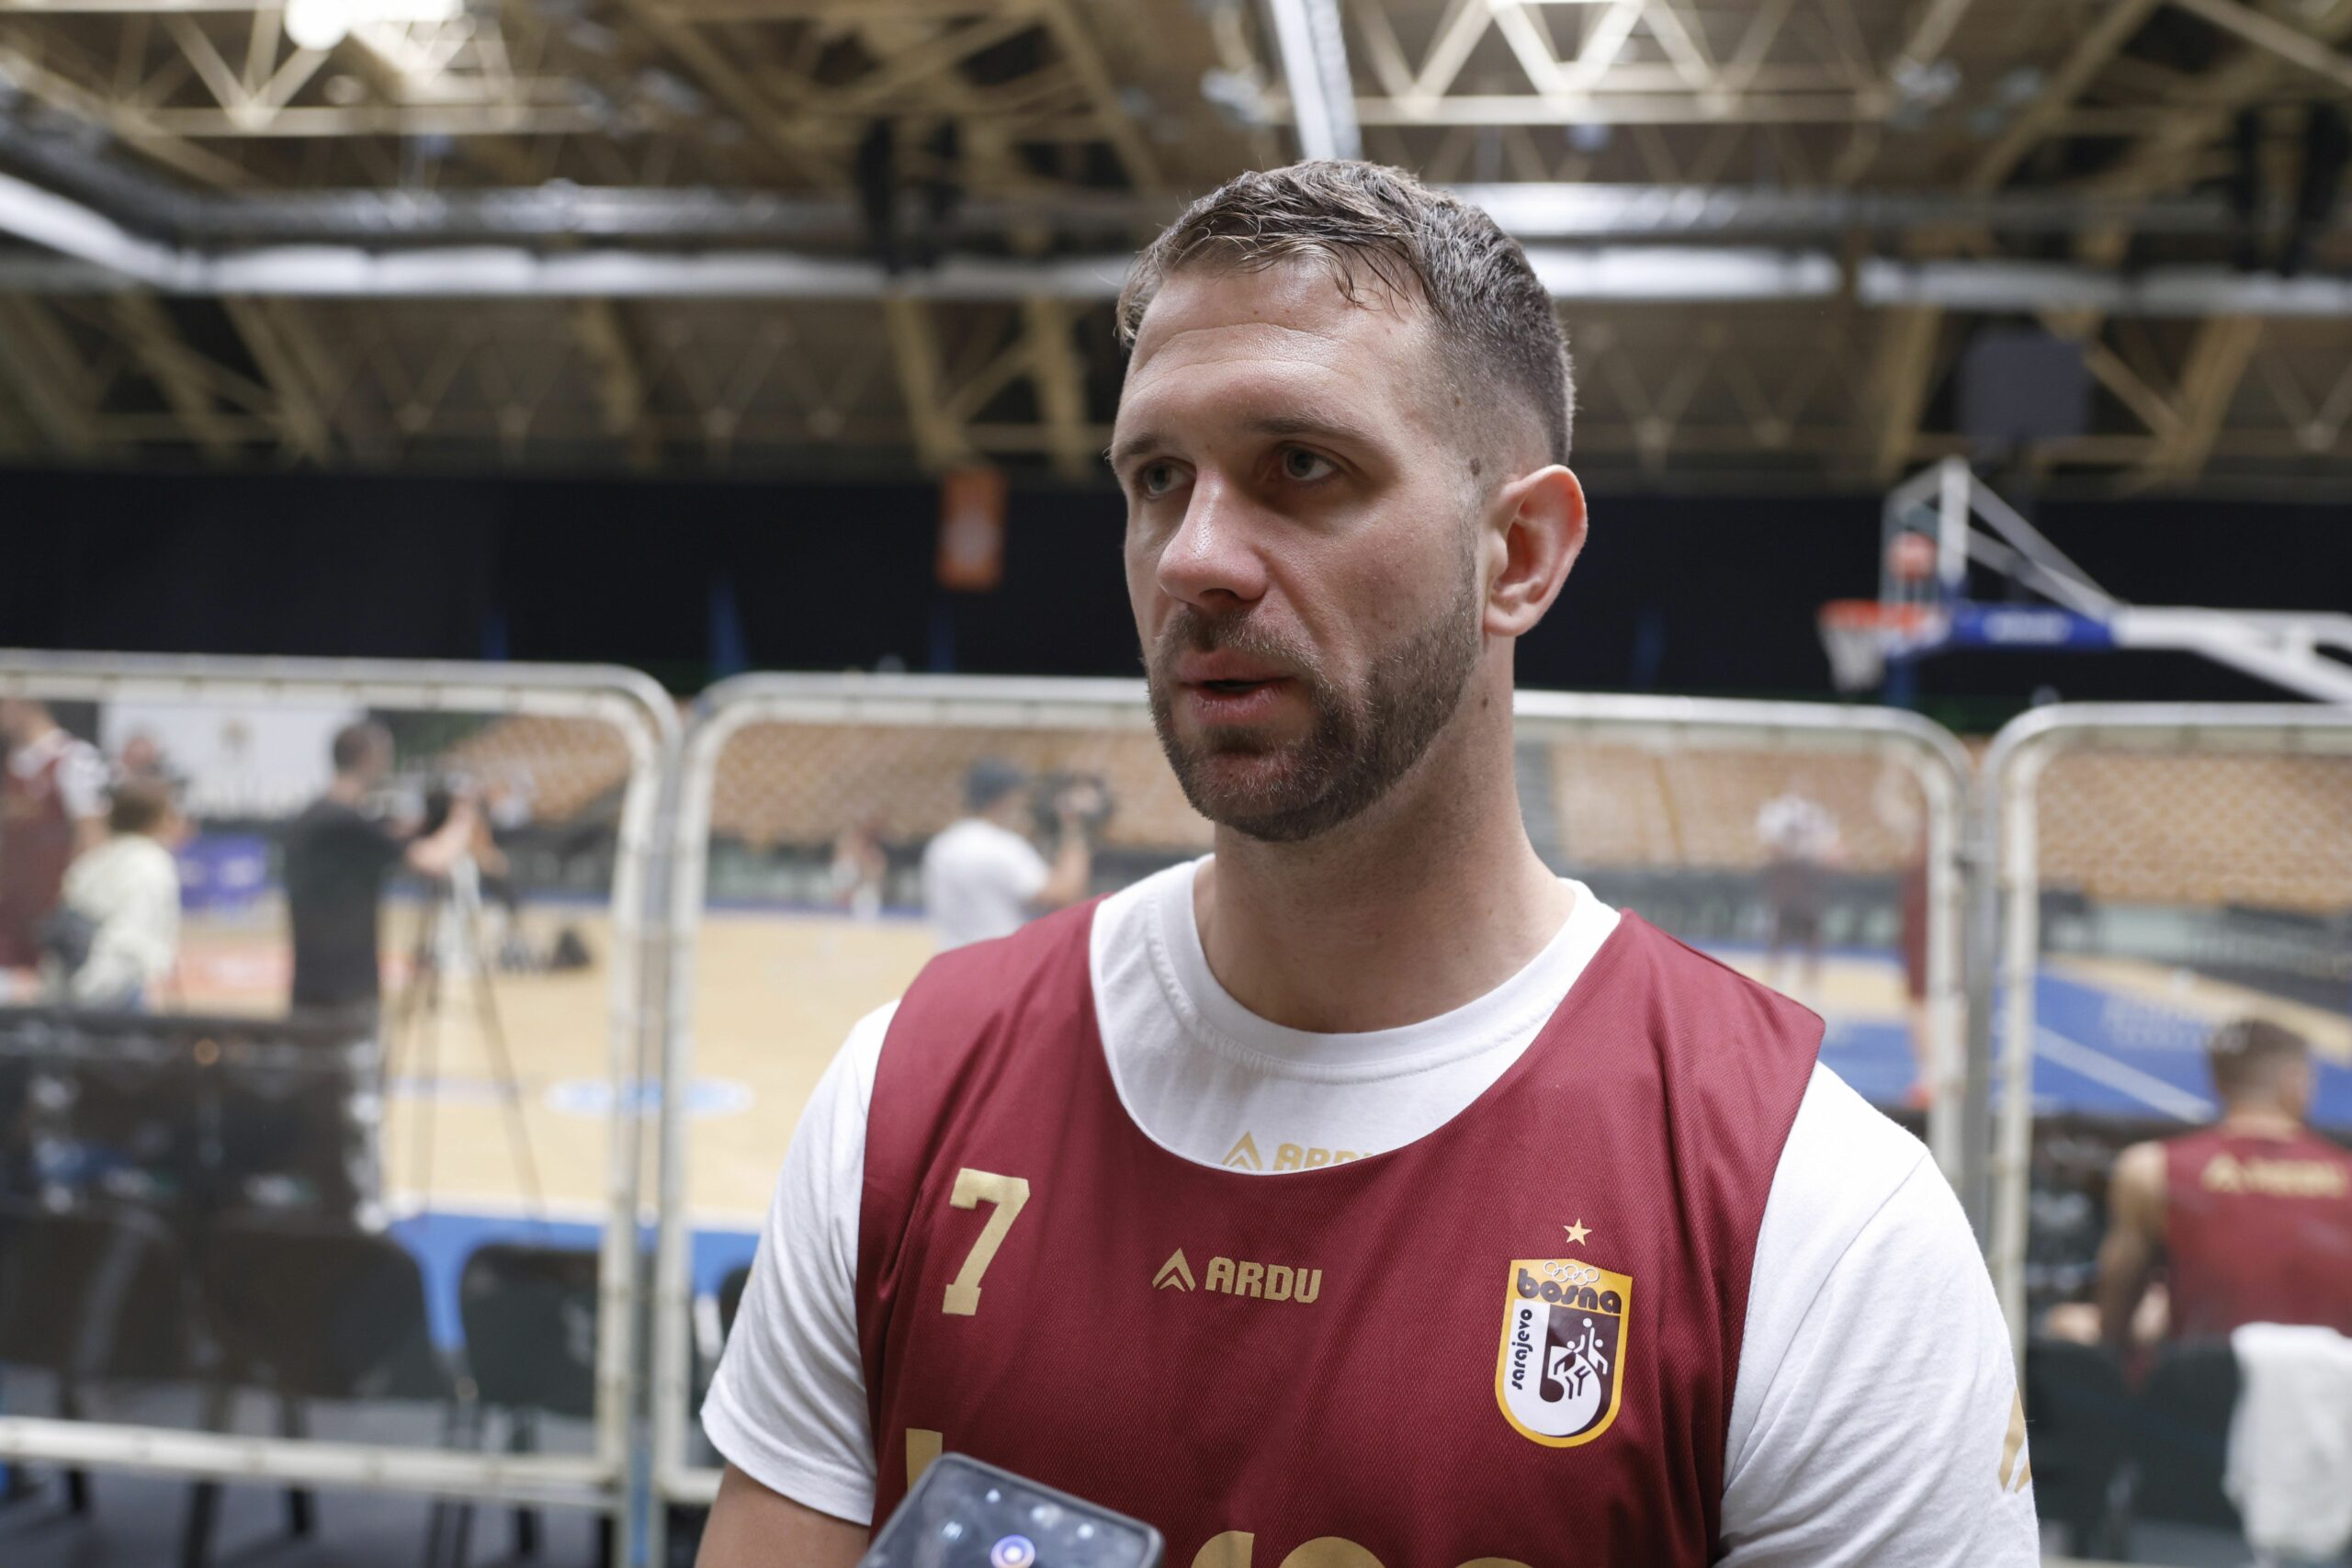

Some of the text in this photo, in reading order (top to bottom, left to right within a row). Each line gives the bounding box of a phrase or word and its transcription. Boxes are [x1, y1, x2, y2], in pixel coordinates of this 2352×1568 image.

[943, 1168, 1030, 1315] 7
[1204, 1256, 1323, 1303] ARDU
[1516, 1268, 1622, 1314] bosna
[1511, 1308, 1533, 1390] sarajevo
